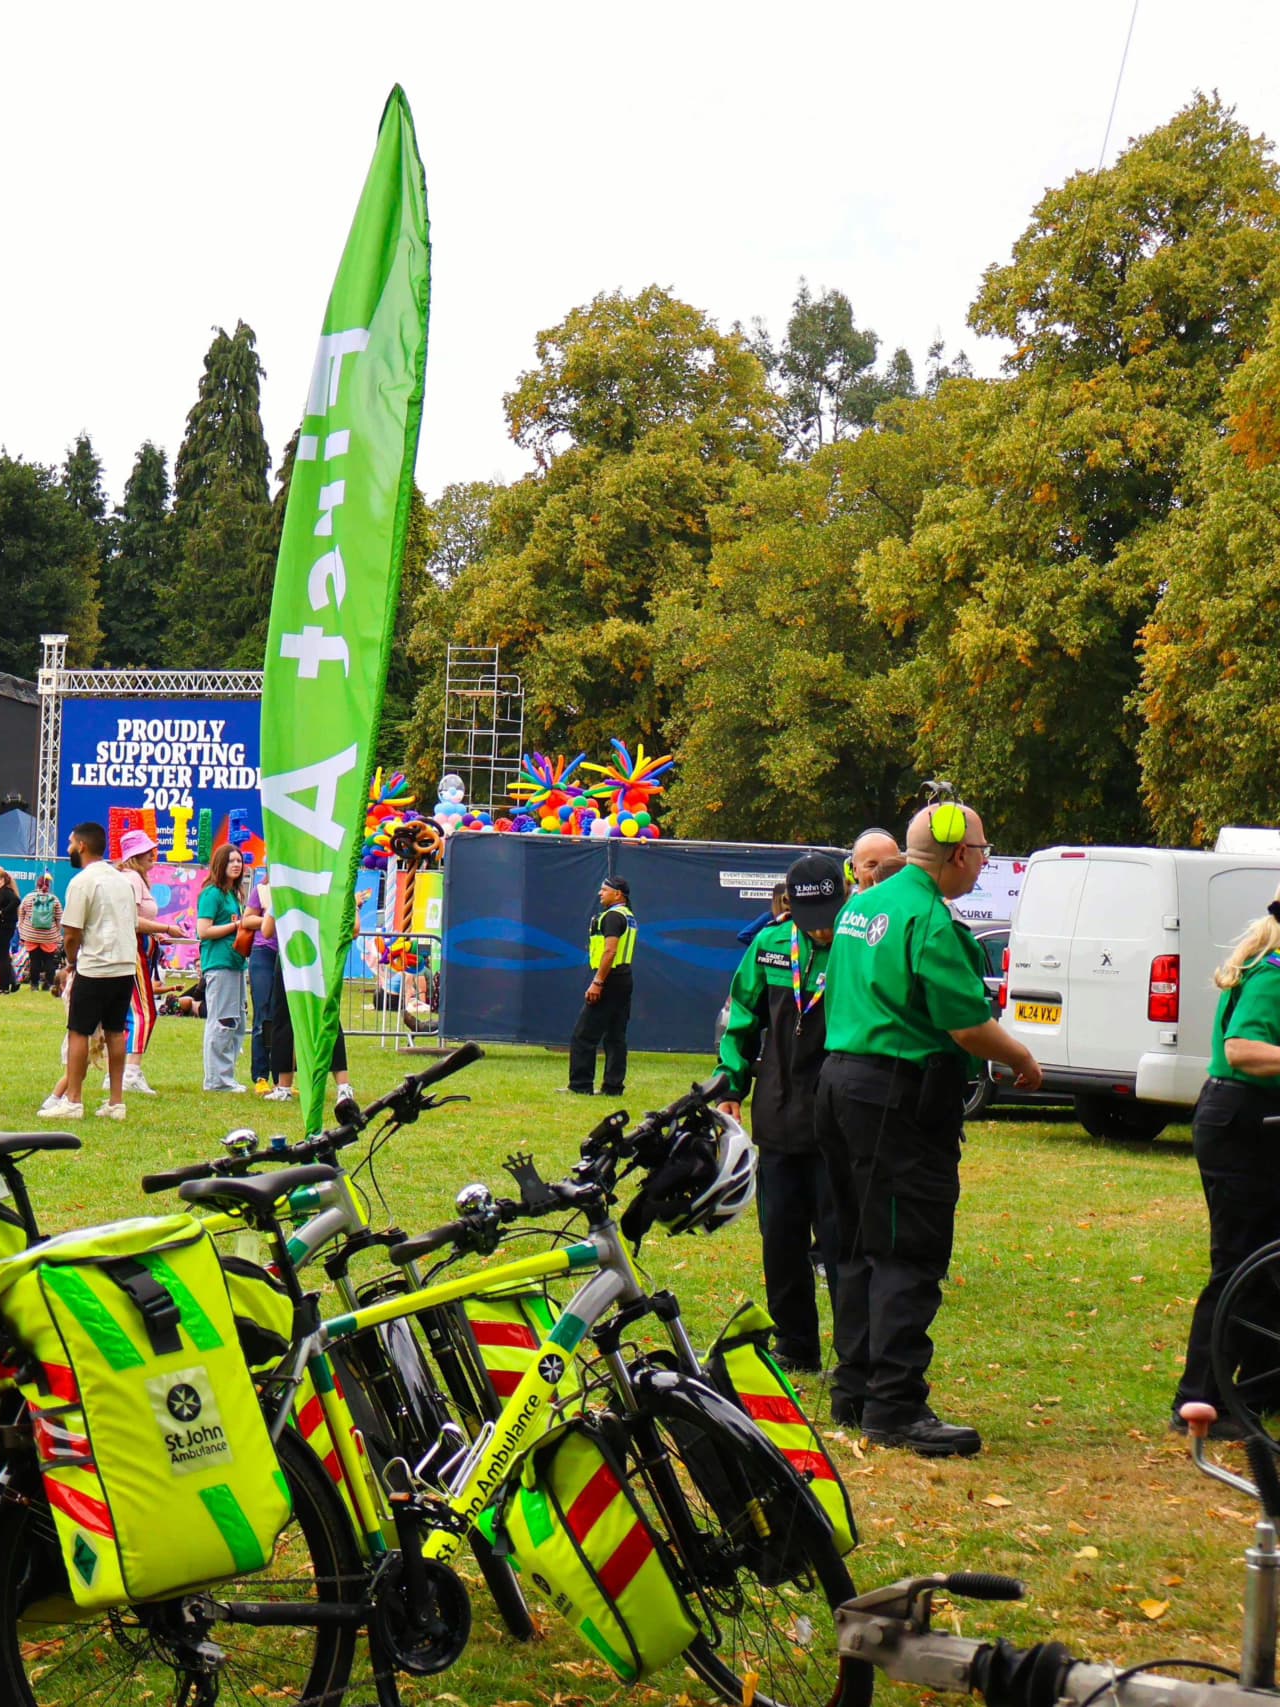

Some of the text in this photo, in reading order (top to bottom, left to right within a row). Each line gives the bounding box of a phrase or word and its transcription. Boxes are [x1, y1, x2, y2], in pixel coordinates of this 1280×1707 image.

[117, 719, 226, 742] PROUDLY
[96, 742, 246, 766] SUPPORTING
[71, 763, 192, 788] LEICESTER
[143, 788, 194, 811] 2024
[164, 1425, 224, 1452] St John
[476, 1394, 542, 1497] Ambulance
[171, 1441, 227, 1465] Ambulance
